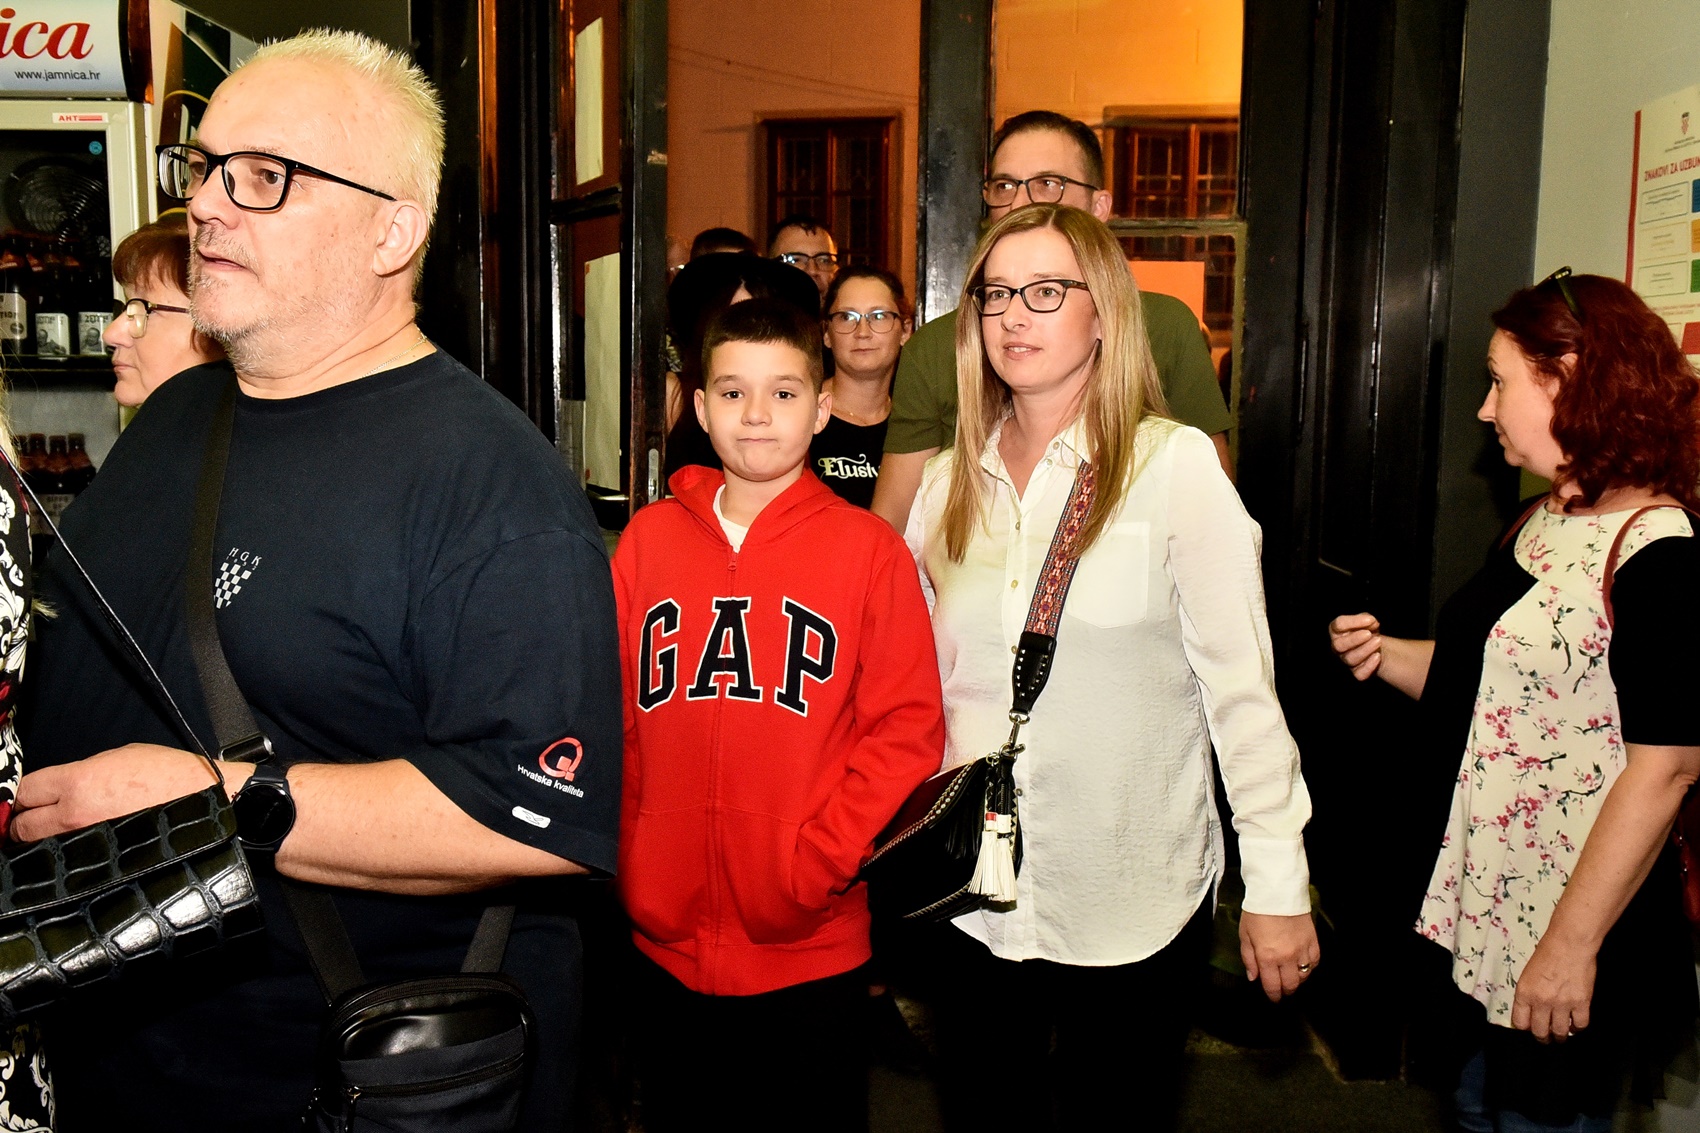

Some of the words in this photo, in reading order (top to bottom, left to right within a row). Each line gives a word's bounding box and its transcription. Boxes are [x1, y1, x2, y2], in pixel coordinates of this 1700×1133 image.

[15, 69, 101, 81] www.jamnica.hr
[228, 547, 262, 567] HGK
[637, 595, 838, 718] GAP
[517, 764, 553, 787] Hrvatska
[553, 780, 584, 798] kvaliteta
